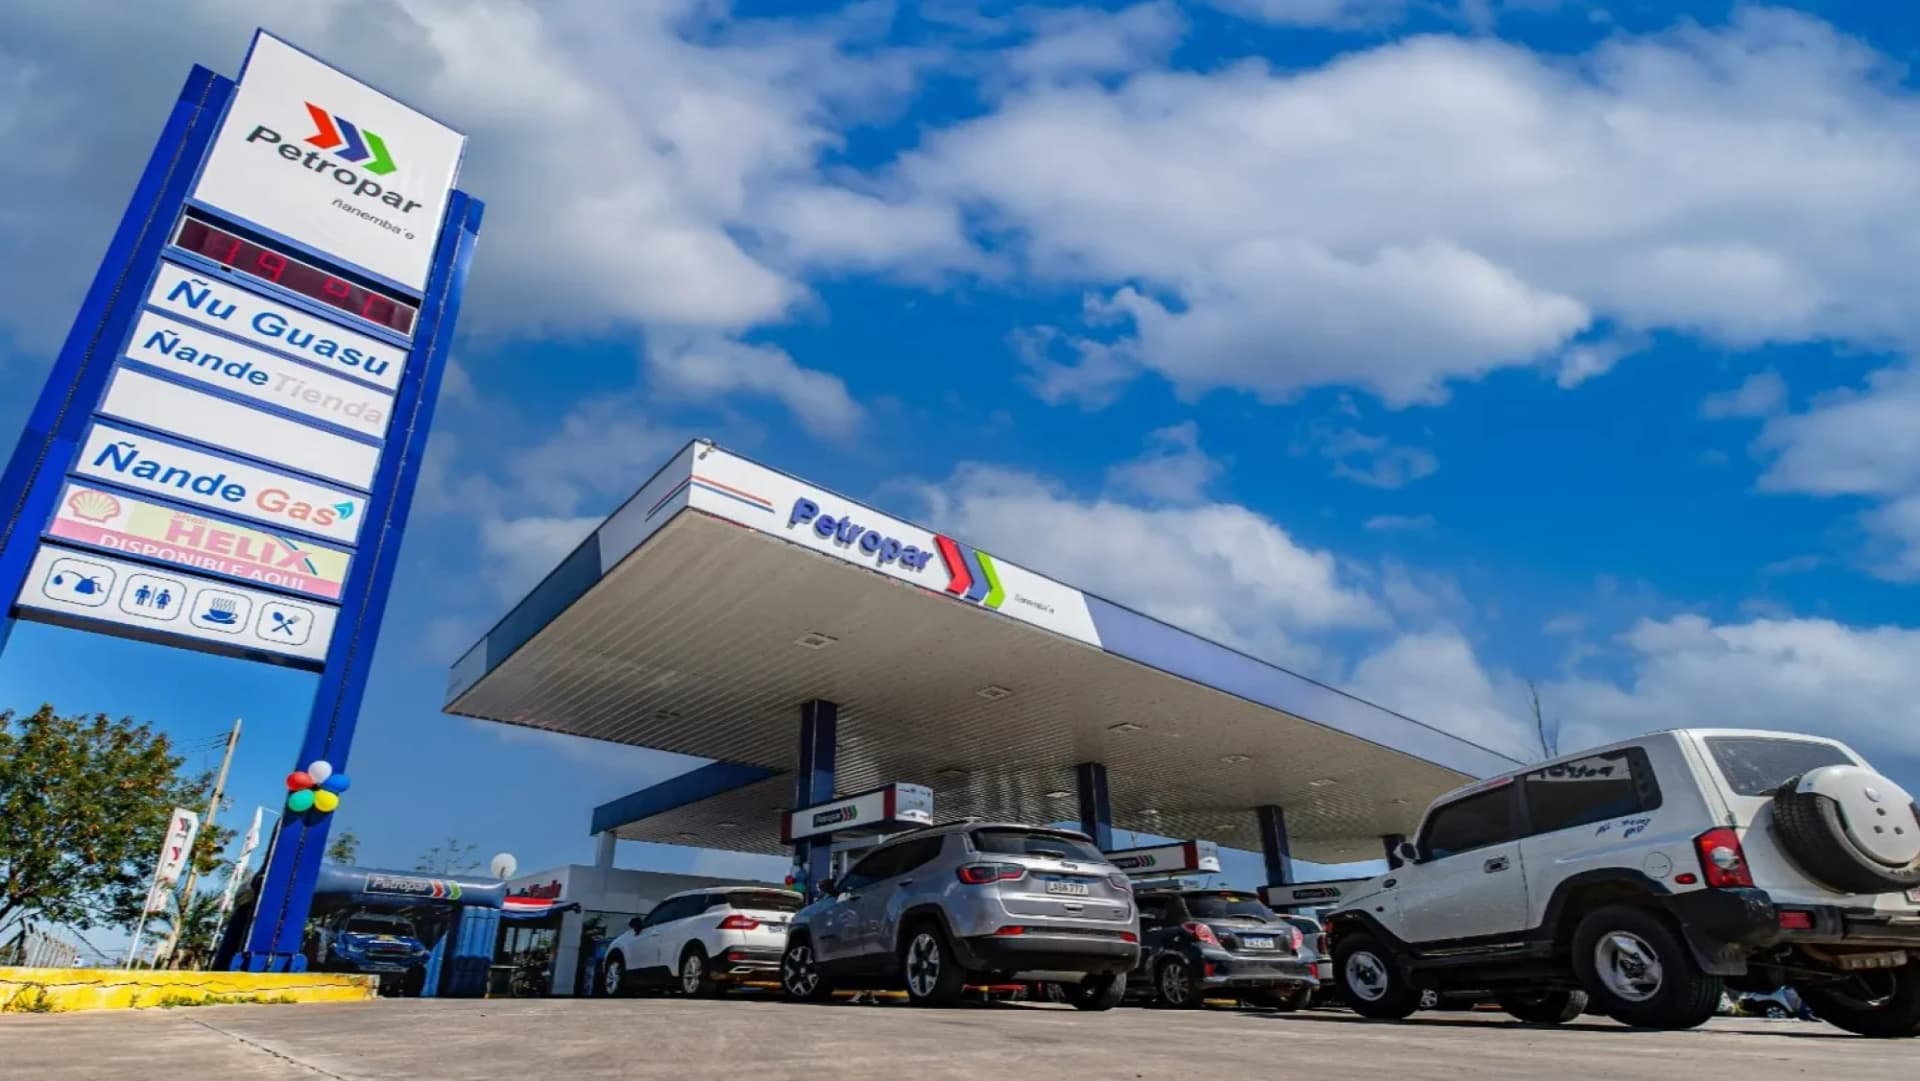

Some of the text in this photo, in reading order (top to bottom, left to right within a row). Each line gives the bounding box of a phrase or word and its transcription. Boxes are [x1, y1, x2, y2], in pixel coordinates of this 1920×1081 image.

[246, 125, 422, 214] Petropar
[167, 278, 388, 376] Ñu Guasu
[93, 442, 336, 527] Ñande Gas
[165, 518, 314, 576] HELIX
[788, 498, 933, 573] Petropar
[373, 876, 430, 892] Petropar
